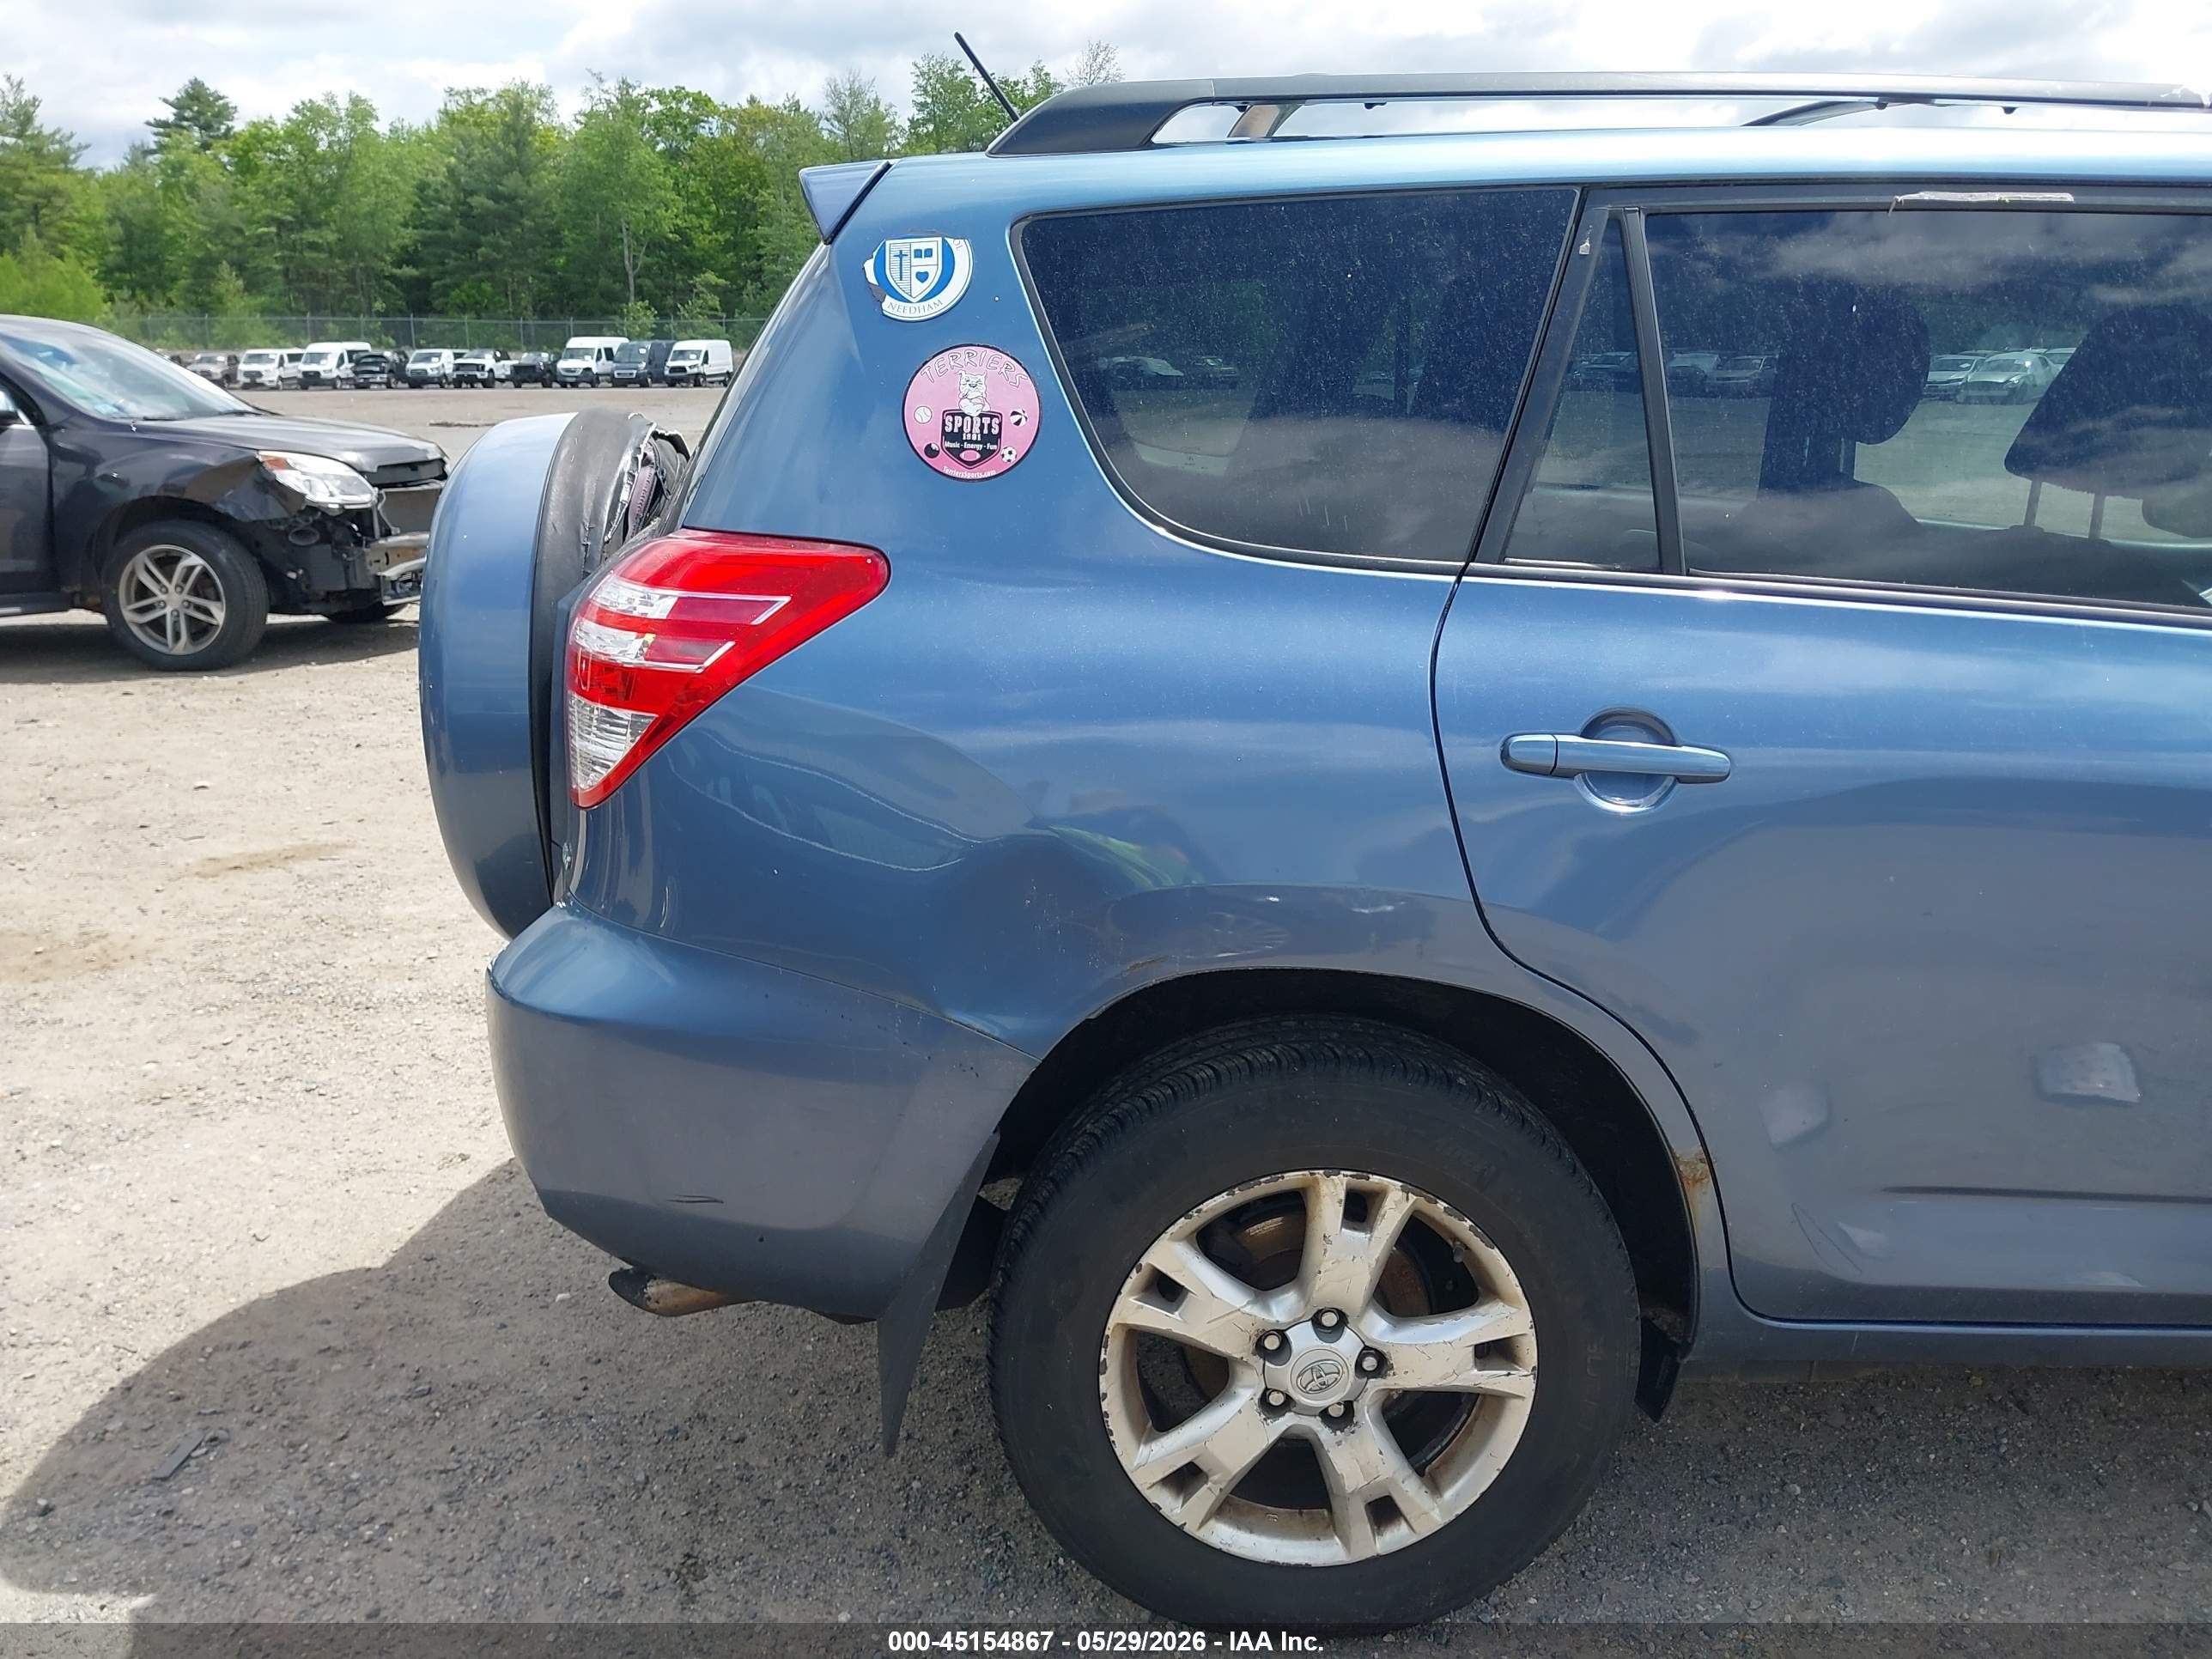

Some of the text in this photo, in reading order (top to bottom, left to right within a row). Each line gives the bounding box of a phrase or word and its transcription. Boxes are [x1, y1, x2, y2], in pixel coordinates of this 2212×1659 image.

[887, 299, 943, 315] NEEDHAM
[921, 349, 1029, 388] TERRIERS
[945, 416, 1000, 434] SPORTS
[963, 441, 983, 451] Energy
